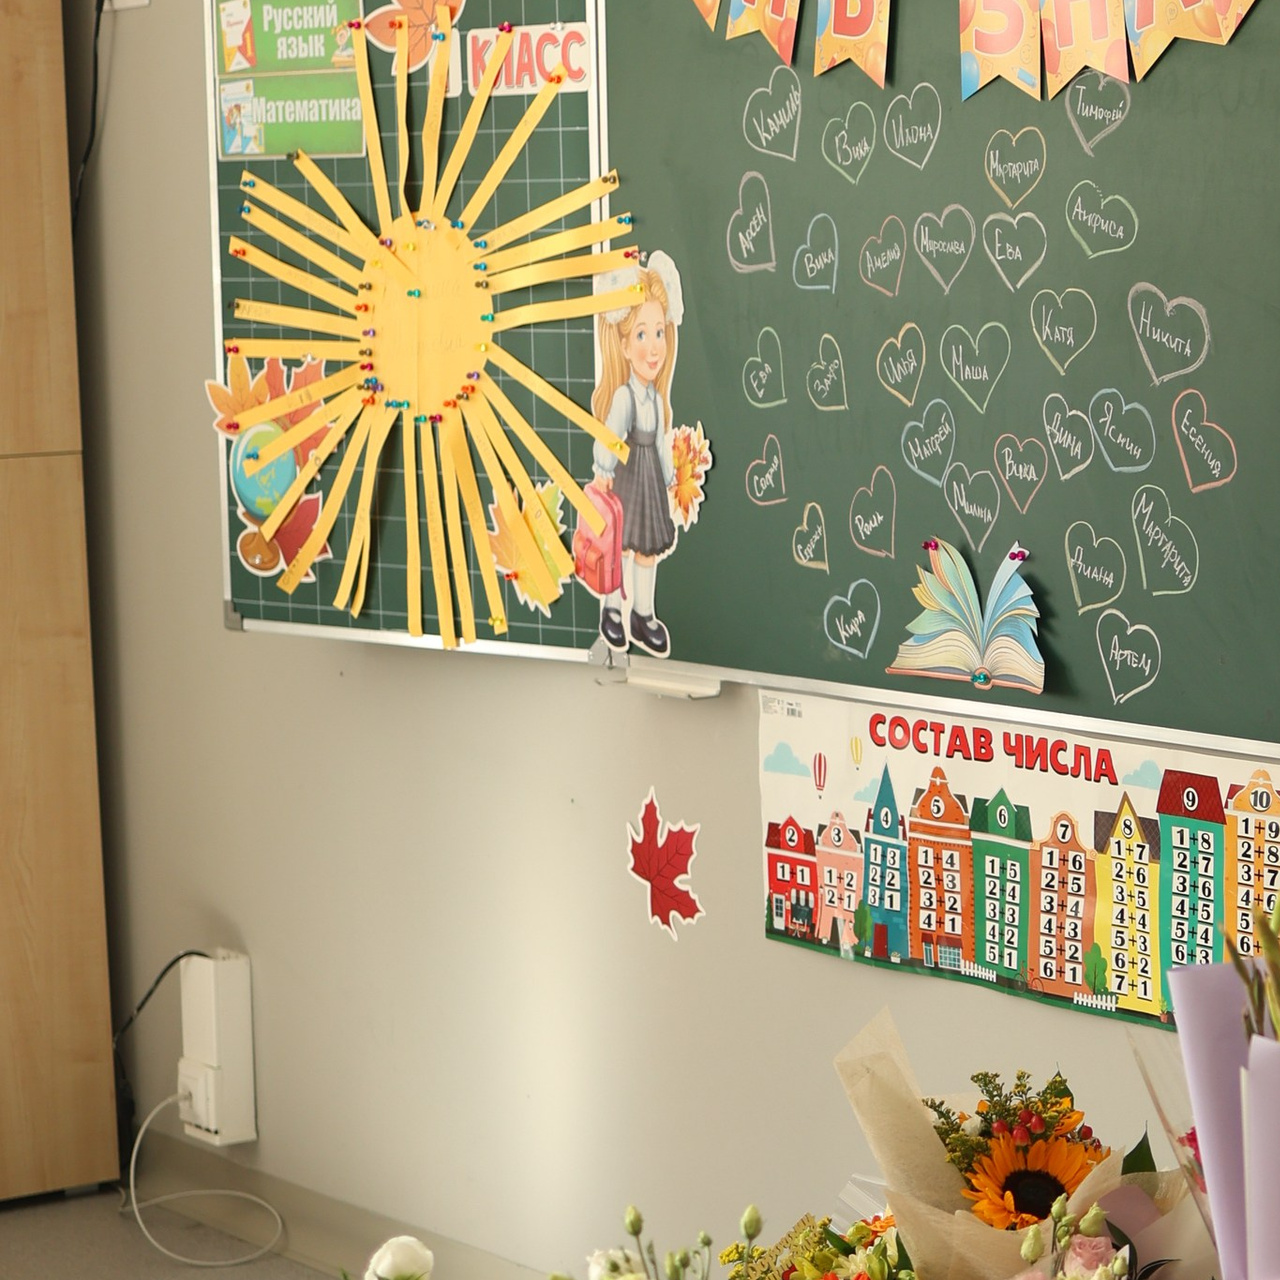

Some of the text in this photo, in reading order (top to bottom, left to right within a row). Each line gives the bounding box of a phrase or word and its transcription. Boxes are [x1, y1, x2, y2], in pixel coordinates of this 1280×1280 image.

[252, 97, 362, 124] Математика
[869, 713, 1119, 786] СОСТАВ ЧИСЛА
[932, 799, 940, 815] 5
[1186, 791, 1196, 808] 9
[1251, 791, 1270, 809] 10
[881, 810, 891, 825] 4
[999, 808, 1006, 825] 6
[787, 828, 796, 842] 2
[833, 828, 841, 842] 3
[1060, 824, 1069, 840] 7
[1123, 819, 1133, 836] 8
